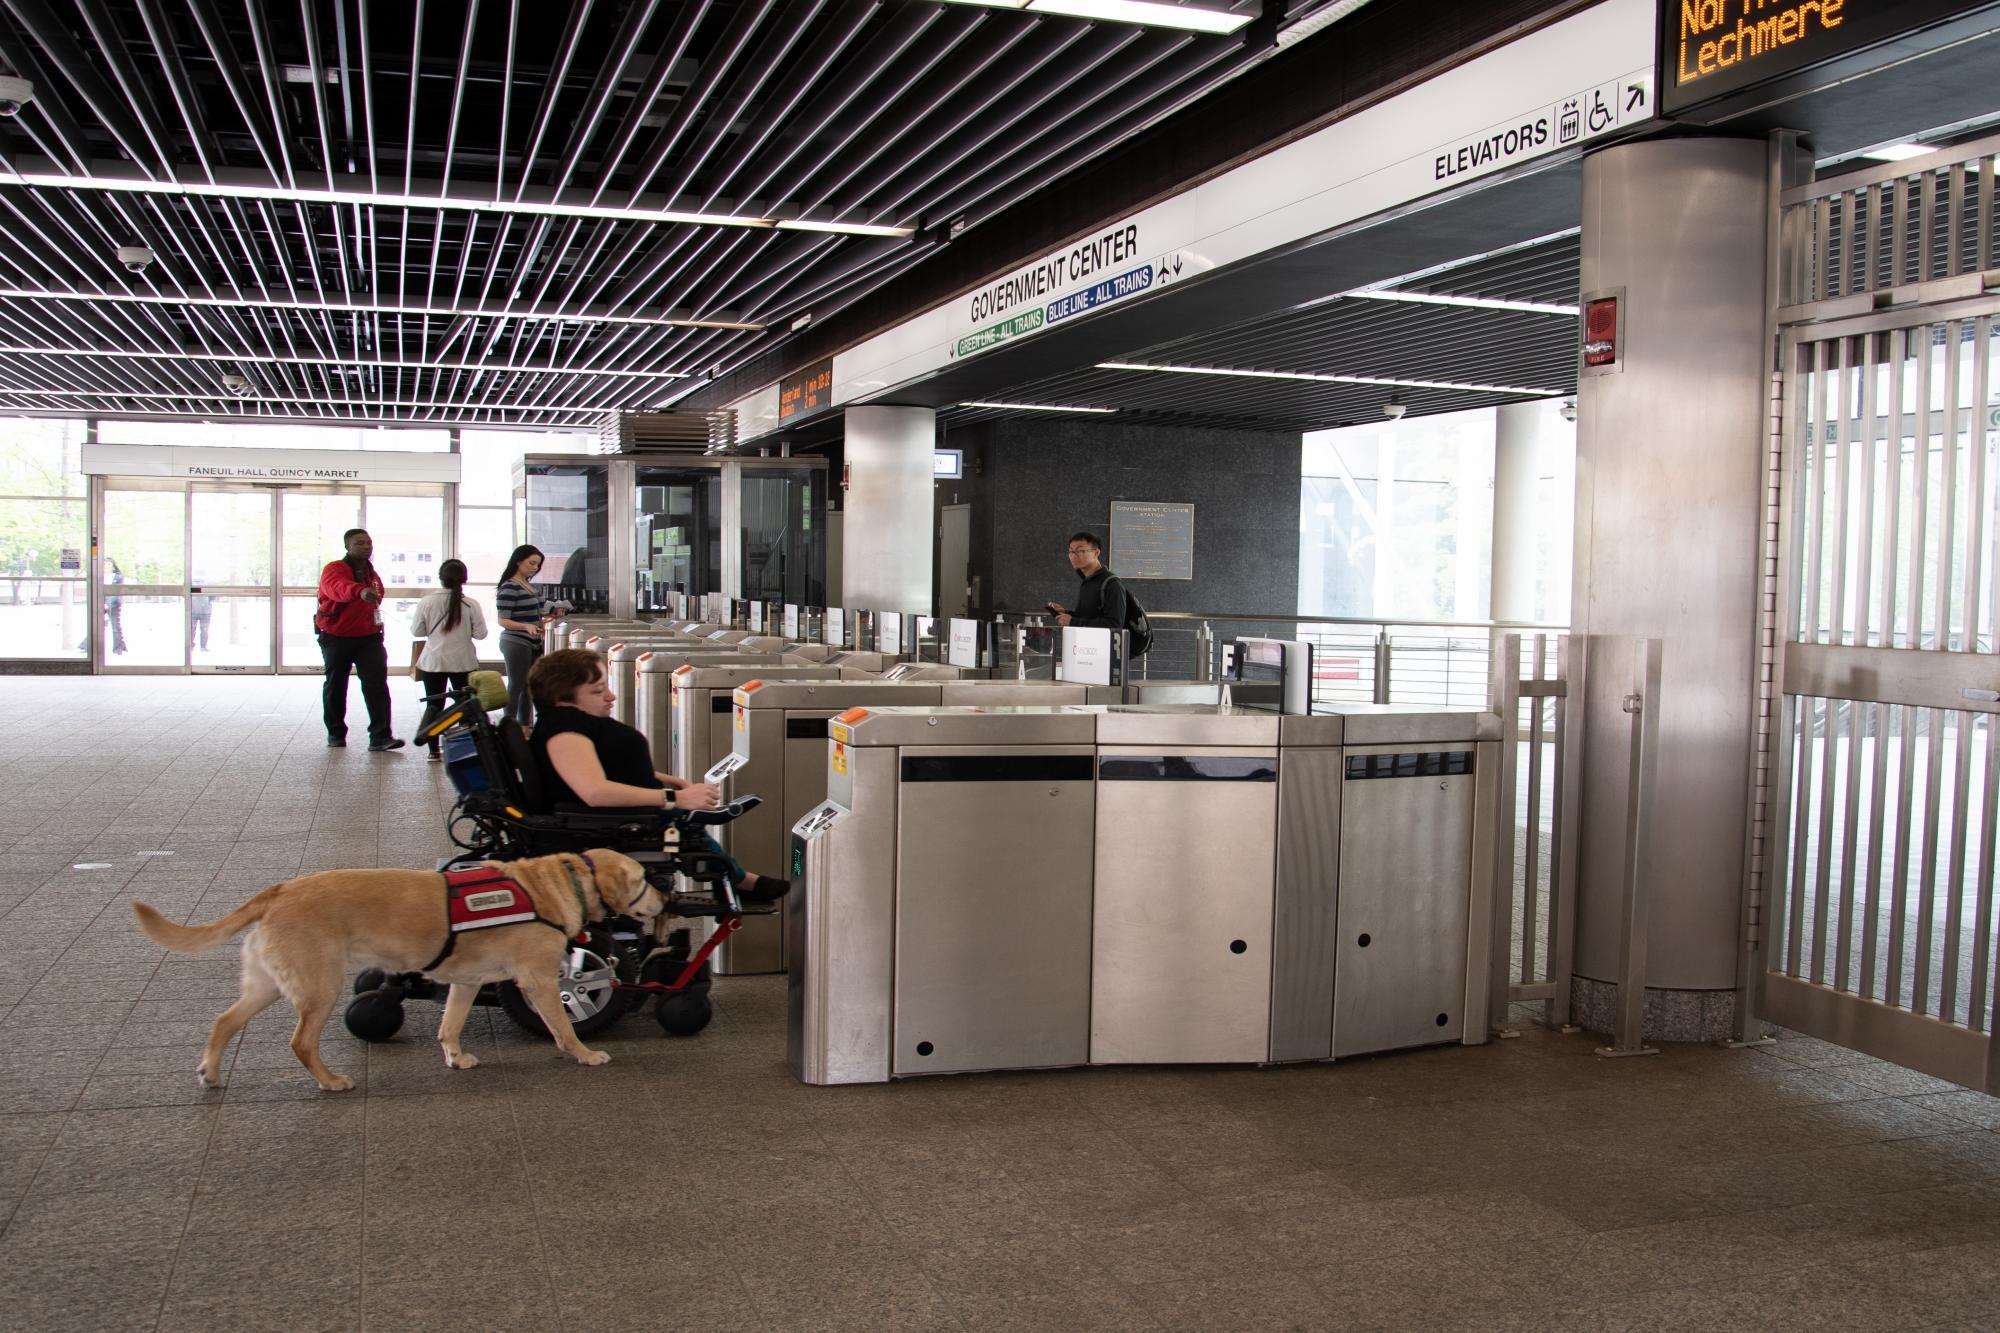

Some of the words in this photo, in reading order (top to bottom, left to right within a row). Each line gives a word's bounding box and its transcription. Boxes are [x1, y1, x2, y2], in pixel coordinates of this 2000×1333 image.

[1679, 0, 1844, 82] Lechmere
[1681, 0, 1778, 39] Nor
[1435, 118, 1548, 181] ELEVATORS
[971, 256, 1066, 323] GOVERNMENT
[1069, 223, 1138, 281] CENTER
[1048, 302, 1069, 321] BLUE
[1070, 294, 1089, 313] LINE
[1095, 283, 1112, 302] ALL
[1113, 268, 1150, 296] TRAINS
[959, 335, 981, 354] GREEN
[981, 328, 996, 346] LINE
[1000, 322, 1014, 339] ALL
[1014, 310, 1042, 334] TRAINS
[189, 466, 234, 475] FANEUIL
[237, 468, 267, 477] HALL,
[270, 468, 311, 477] QUINCY
[314, 470, 359, 478] MARKET
